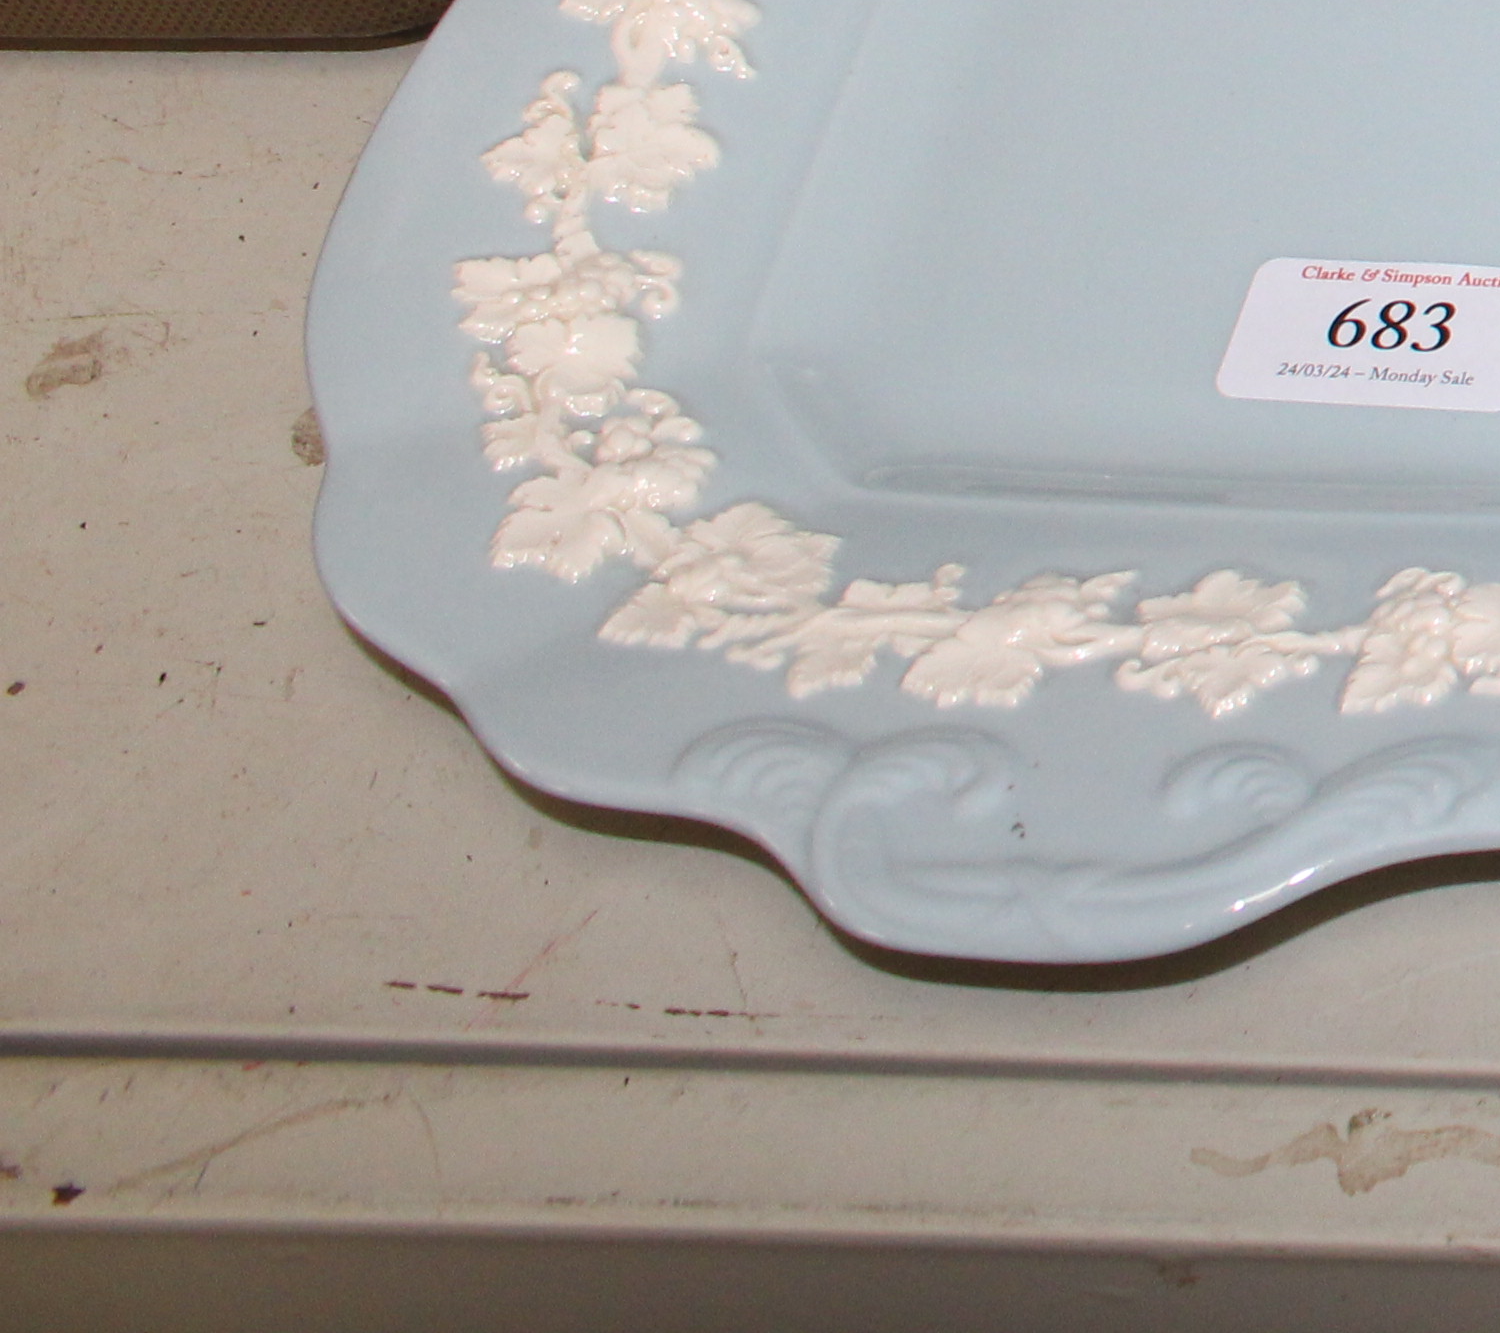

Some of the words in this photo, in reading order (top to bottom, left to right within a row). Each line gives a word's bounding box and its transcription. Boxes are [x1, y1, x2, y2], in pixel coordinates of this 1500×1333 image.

[1301, 265, 1355, 282] Clarke
[1361, 268, 1380, 282] &
[1381, 268, 1452, 288] Simpson
[1326, 298, 1457, 352] 683
[1369, 366, 1437, 388] Monday
[1440, 369, 1475, 386] Sale
